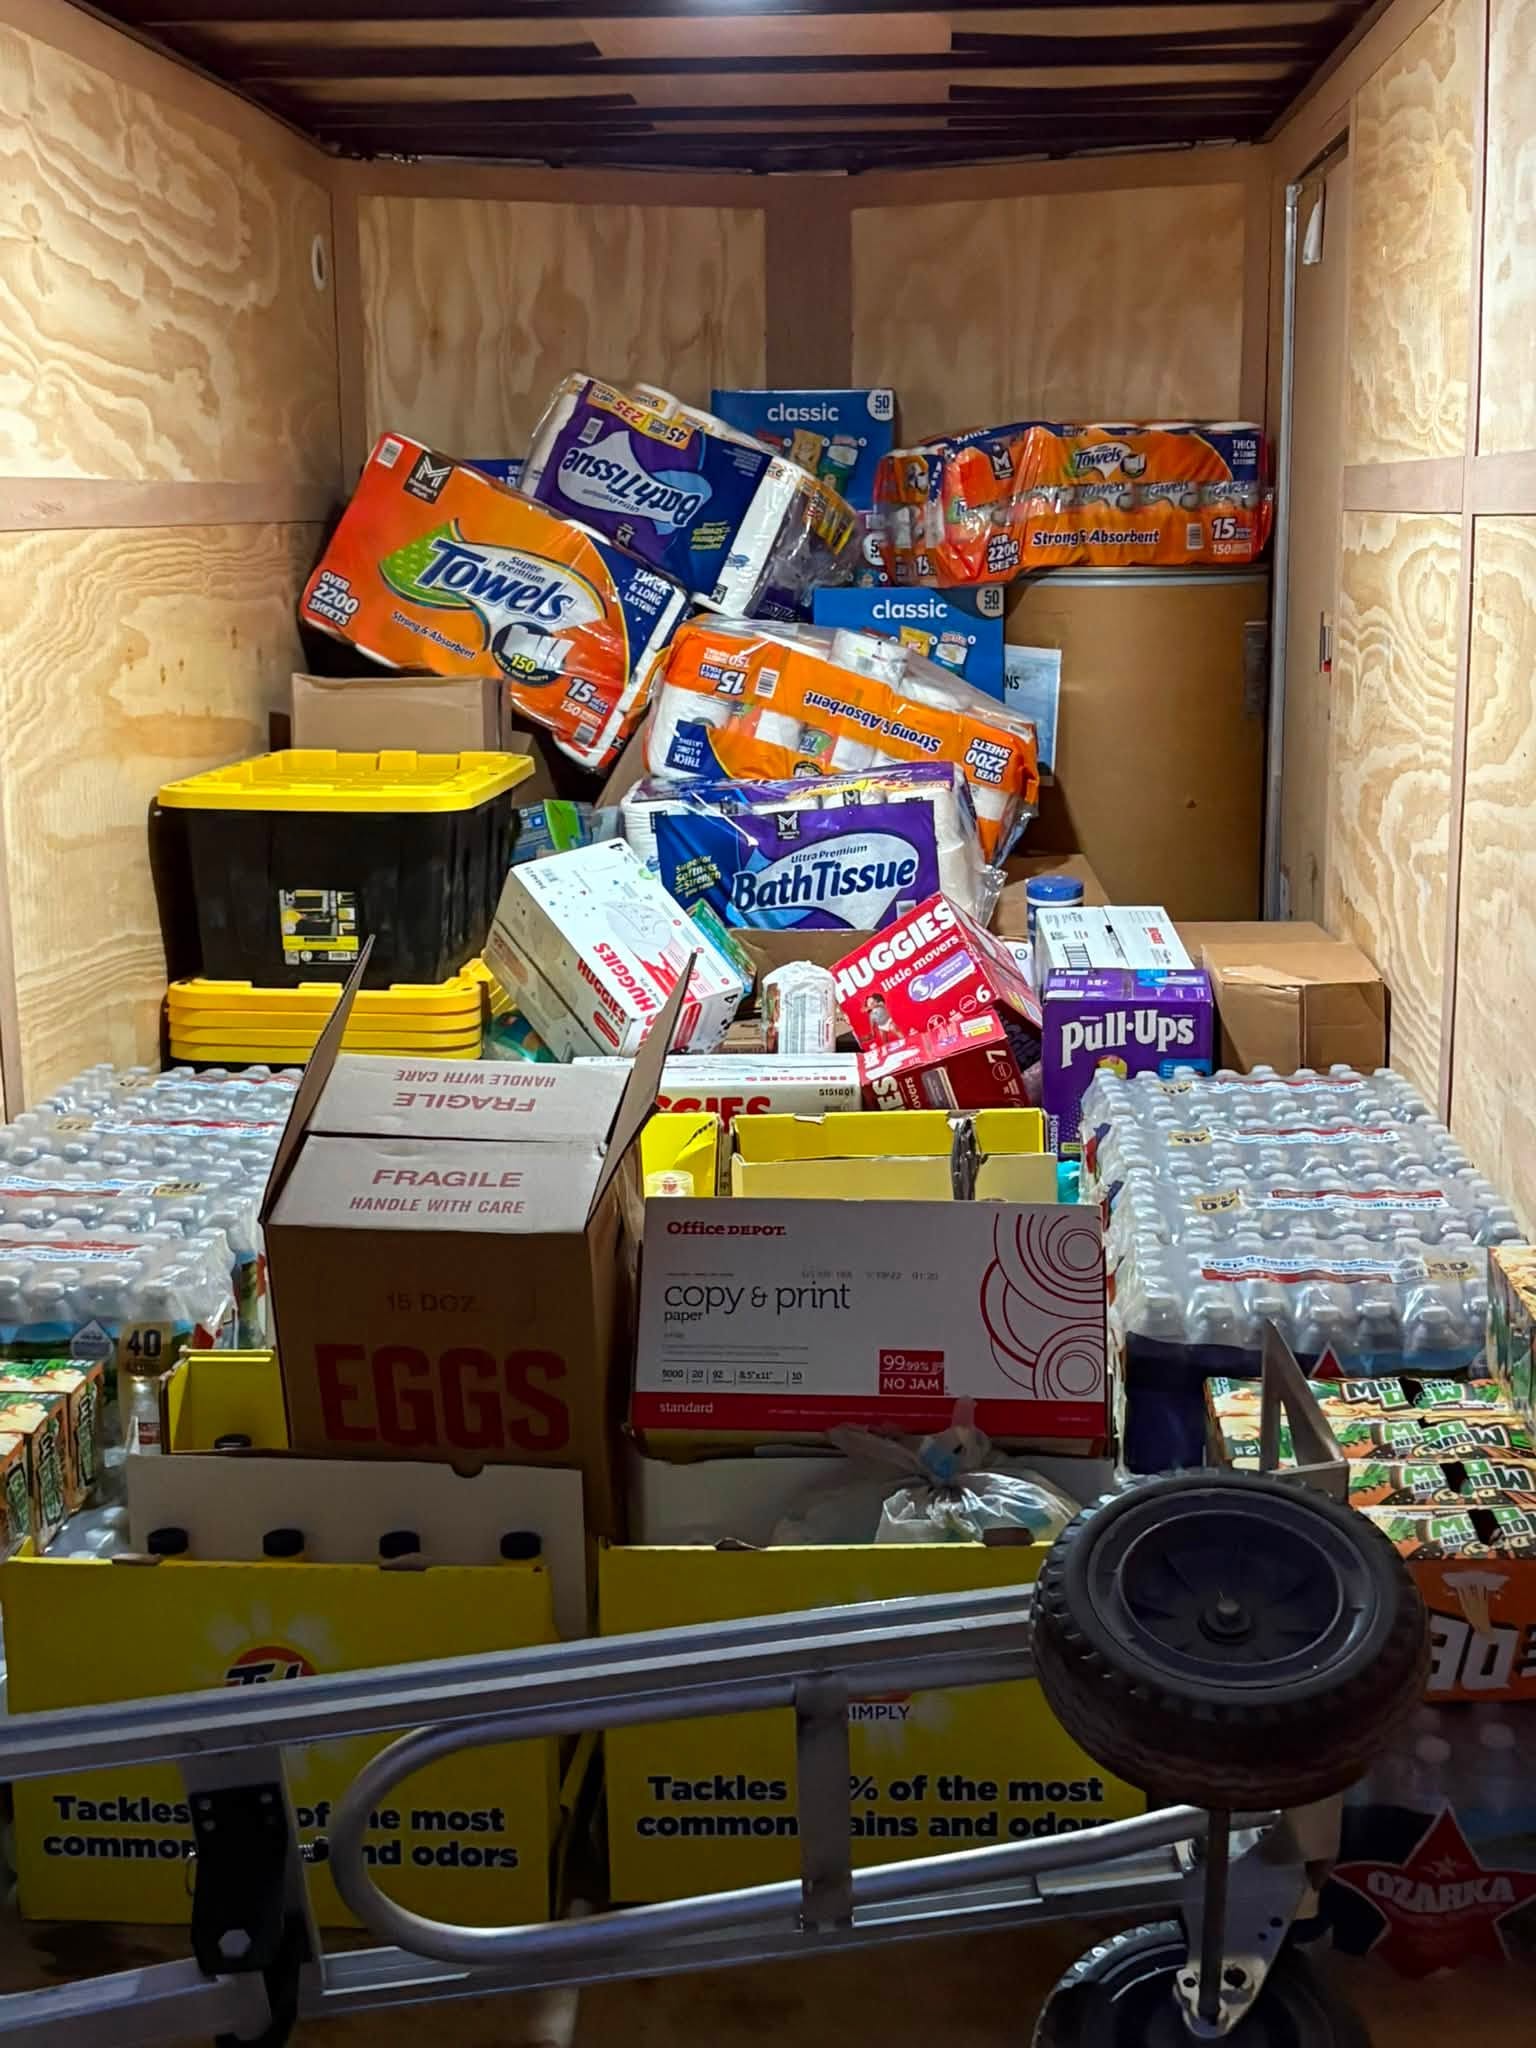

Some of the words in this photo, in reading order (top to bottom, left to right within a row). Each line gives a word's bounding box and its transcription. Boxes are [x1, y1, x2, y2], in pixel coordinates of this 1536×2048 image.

[613, 400, 644, 424] 235
[768, 402, 840, 422] classic
[875, 395, 890, 409] 50
[667, 426, 688, 443] 45
[1075, 447, 1122, 470] Towels
[1033, 531, 1079, 546] Strong
[1089, 529, 1160, 544] Absorbent
[1212, 516, 1237, 541] 15
[987, 540, 1019, 562] 2200
[497, 560, 547, 584] Premium
[509, 557, 544, 573] Super
[321, 570, 350, 591] OVER
[416, 538, 574, 622] Towels
[312, 582, 360, 615] 2200
[624, 593, 657, 617] LASTING
[638, 585, 663, 605] LONG
[984, 589, 1000, 605] 50
[308, 598, 350, 626] SHEETS
[872, 599, 949, 619] classic
[392, 611, 422, 633] Strong
[431, 631, 476, 659] Absorbent
[511, 654, 537, 673] 150
[567, 678, 598, 704] 15
[716, 669, 746, 695] 15
[804, 691, 882, 729] Absorbent
[889, 722, 943, 754] Strong
[972, 738, 1012, 758] SHEETS
[672, 753, 700, 768] THICK
[964, 747, 1010, 774] 2200
[975, 768, 1004, 784] OVER
[791, 851, 818, 864] Ultra
[818, 844, 868, 860] Premium
[834, 900, 958, 1004] HUGGIES
[881, 967, 913, 993] little
[912, 934, 960, 970] movers
[593, 942, 657, 1013] HUGGIES
[576, 957, 627, 1025] HUGGIES
[976, 984, 992, 1004] 6
[393, 1070, 439, 1083] CARE
[443, 1071, 485, 1085] WITH
[490, 1074, 556, 1088] HANDLE
[393, 1092, 536, 1113] FRAGILE
[905, 1077, 922, 1110] overs
[372, 1169, 525, 1188] FRAGILE
[349, 1196, 422, 1213] HANDLE
[427, 1198, 473, 1214] WITH
[477, 1200, 525, 1214] CARE
[667, 1221, 725, 1236] Office
[664, 1285, 745, 1315] copy
[751, 1286, 769, 1308] &
[775, 1280, 851, 1316] print
[664, 1310, 703, 1324] paper
[127, 1329, 162, 1357] 40
[883, 1377, 906, 1390] NO
[909, 1377, 940, 1391] JAM
[314, 1344, 571, 1453] EGGS
[658, 1402, 714, 1415] standard
[846, 1704, 911, 1721] IMPLY
[648, 1775, 788, 1801] Tackles
[889, 1775, 927, 1801] of
[936, 1775, 998, 1801] the
[1008, 1777, 1104, 1802] most
[53, 1794, 191, 1825] Tackles
[298, 1801, 331, 1828] of
[411, 1806, 506, 1833] most
[636, 1814, 799, 1837] common
[850, 1811, 918, 1837] ains
[928, 1811, 998, 1837] and
[364, 1841, 401, 1866] nd
[412, 1841, 519, 1869] odors
[1367, 1870, 1518, 1913] OZARKA
